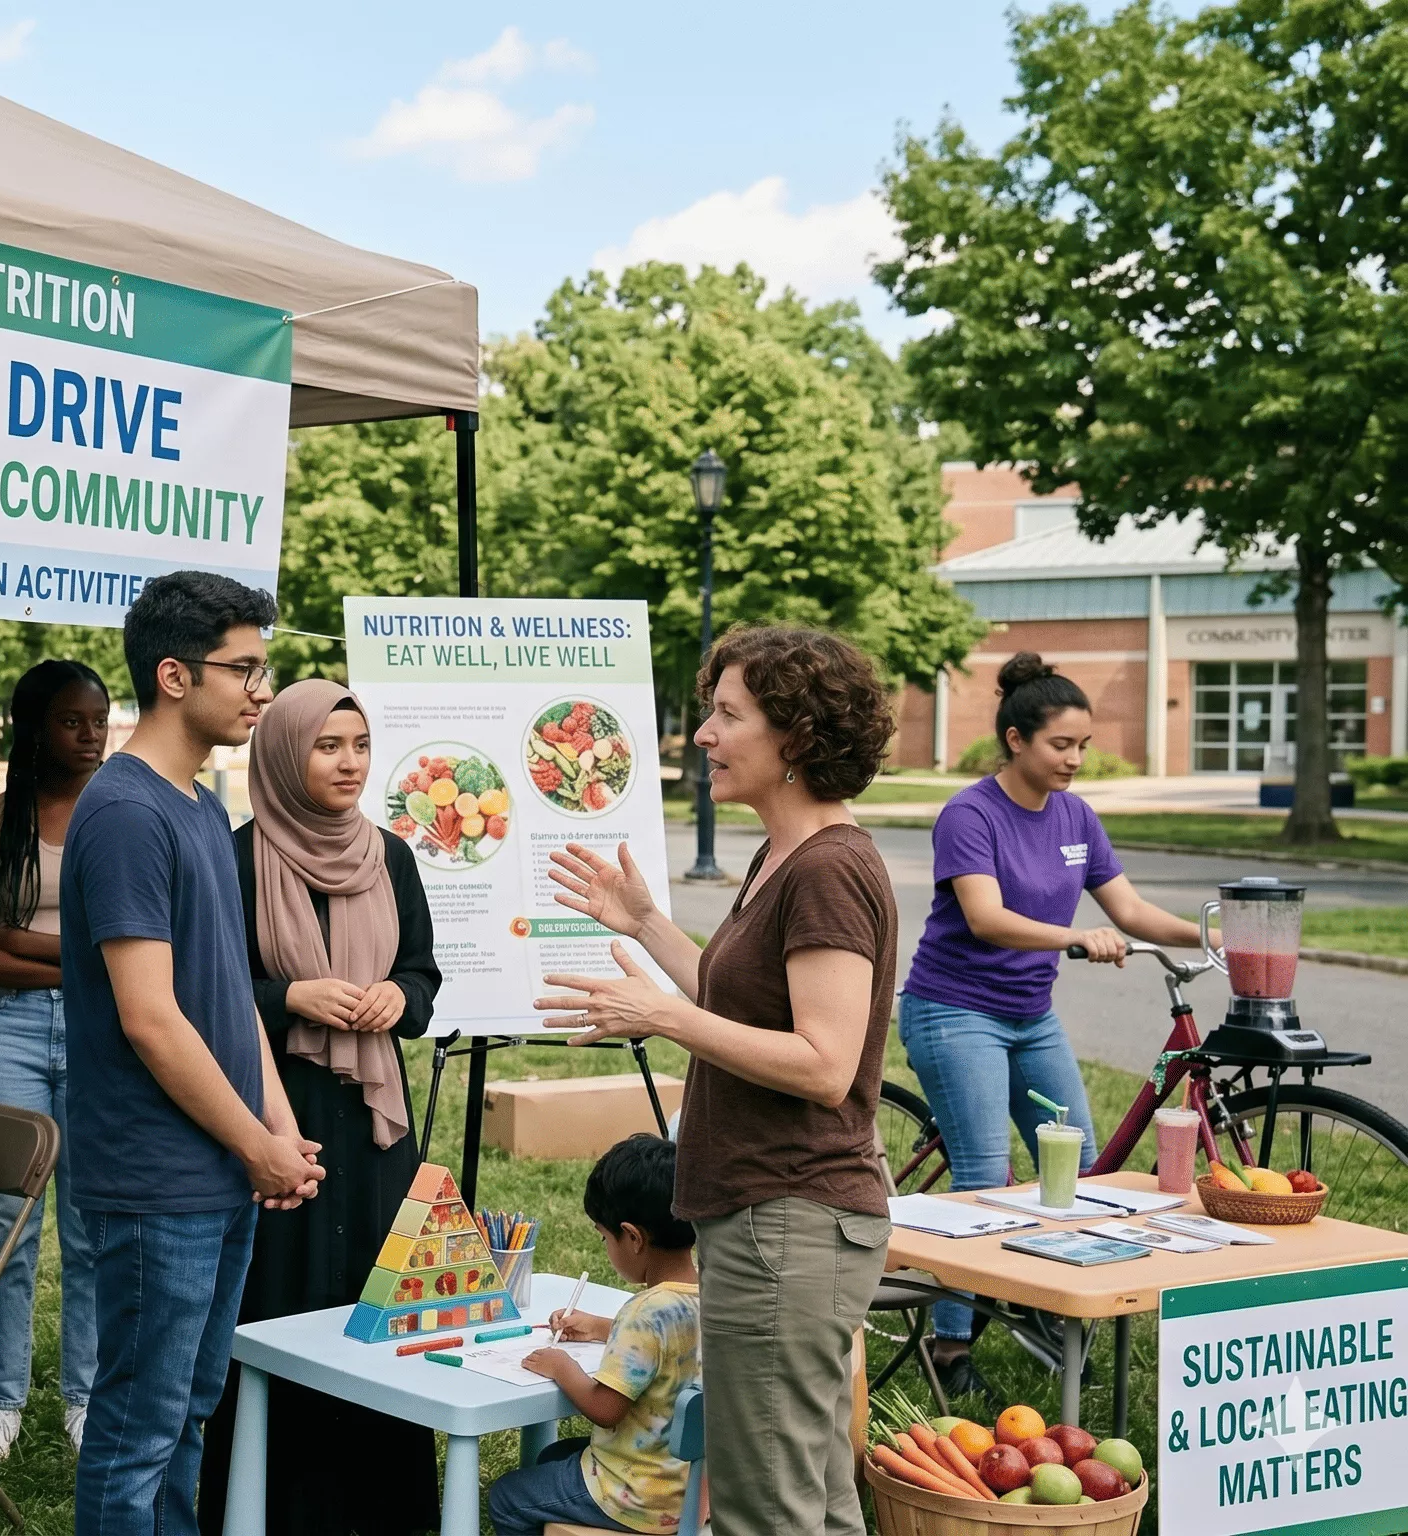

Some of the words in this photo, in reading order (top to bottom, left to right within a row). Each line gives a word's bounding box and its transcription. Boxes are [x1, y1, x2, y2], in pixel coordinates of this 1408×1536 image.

[7, 359, 182, 462] DRIVE
[0, 460, 264, 545] COMMUNITY
[15, 564, 155, 607] ACTIVITIE
[363, 614, 482, 637] NUTRITION
[490, 616, 506, 638] &
[511, 616, 632, 639] WELLNESS:
[386, 644, 426, 667] EAT
[433, 644, 498, 671] WELL,
[505, 646, 551, 667] LIVE
[557, 646, 616, 668] WELL
[1187, 627, 1294, 645] COMMUNITY
[1182, 1318, 1394, 1388] SUSTAINABLE
[1168, 1410, 1190, 1453] &
[1199, 1393, 1296, 1448] LOCAL
[1304, 1376, 1408, 1432] EATING
[1218, 1443, 1362, 1507] MATTERS
